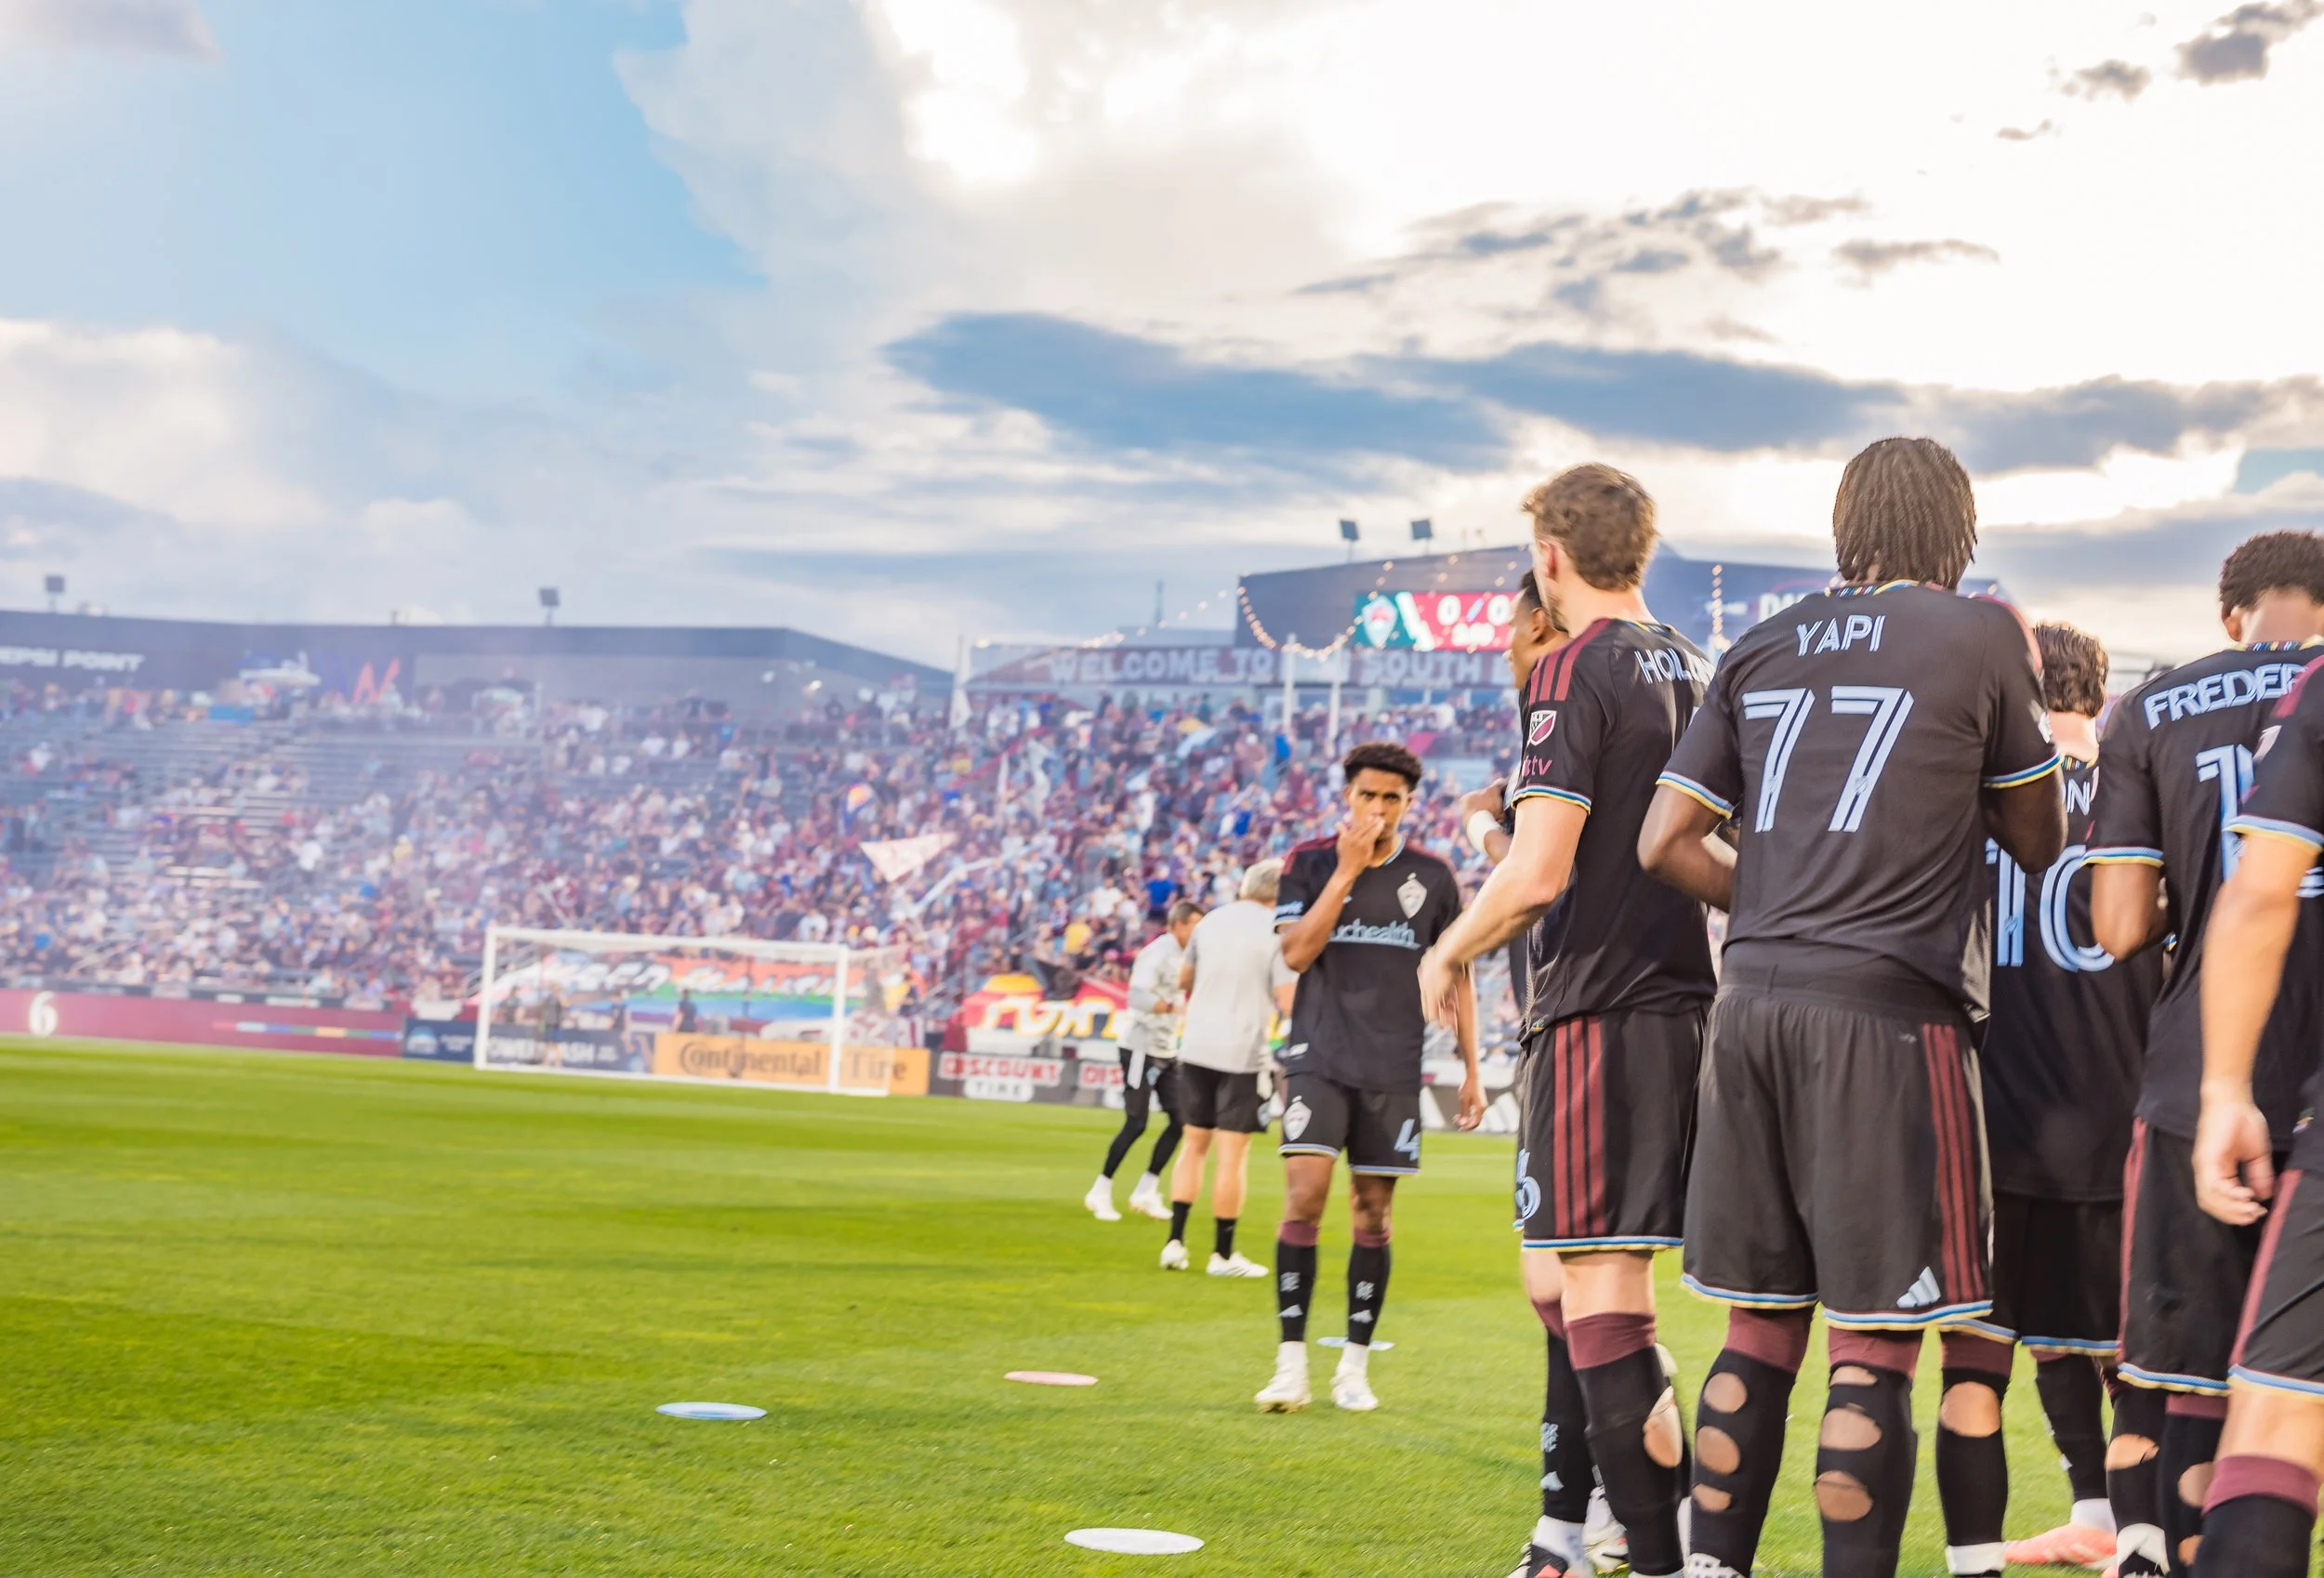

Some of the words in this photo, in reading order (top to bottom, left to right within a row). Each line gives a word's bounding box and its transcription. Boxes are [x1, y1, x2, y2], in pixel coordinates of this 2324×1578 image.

[1796, 614, 1886, 657] YAPI
[1050, 648, 1221, 682] WELCOME
[1231, 648, 1274, 681] TO
[1360, 652, 1483, 686] SOUTH
[1741, 685, 1915, 834] 77
[28, 990, 59, 1038] 6
[679, 1039, 823, 1076] Continental
[847, 1049, 907, 1081] Tire
[942, 1056, 1061, 1086] DISCOUNT
[974, 1080, 1023, 1097] TIRE
